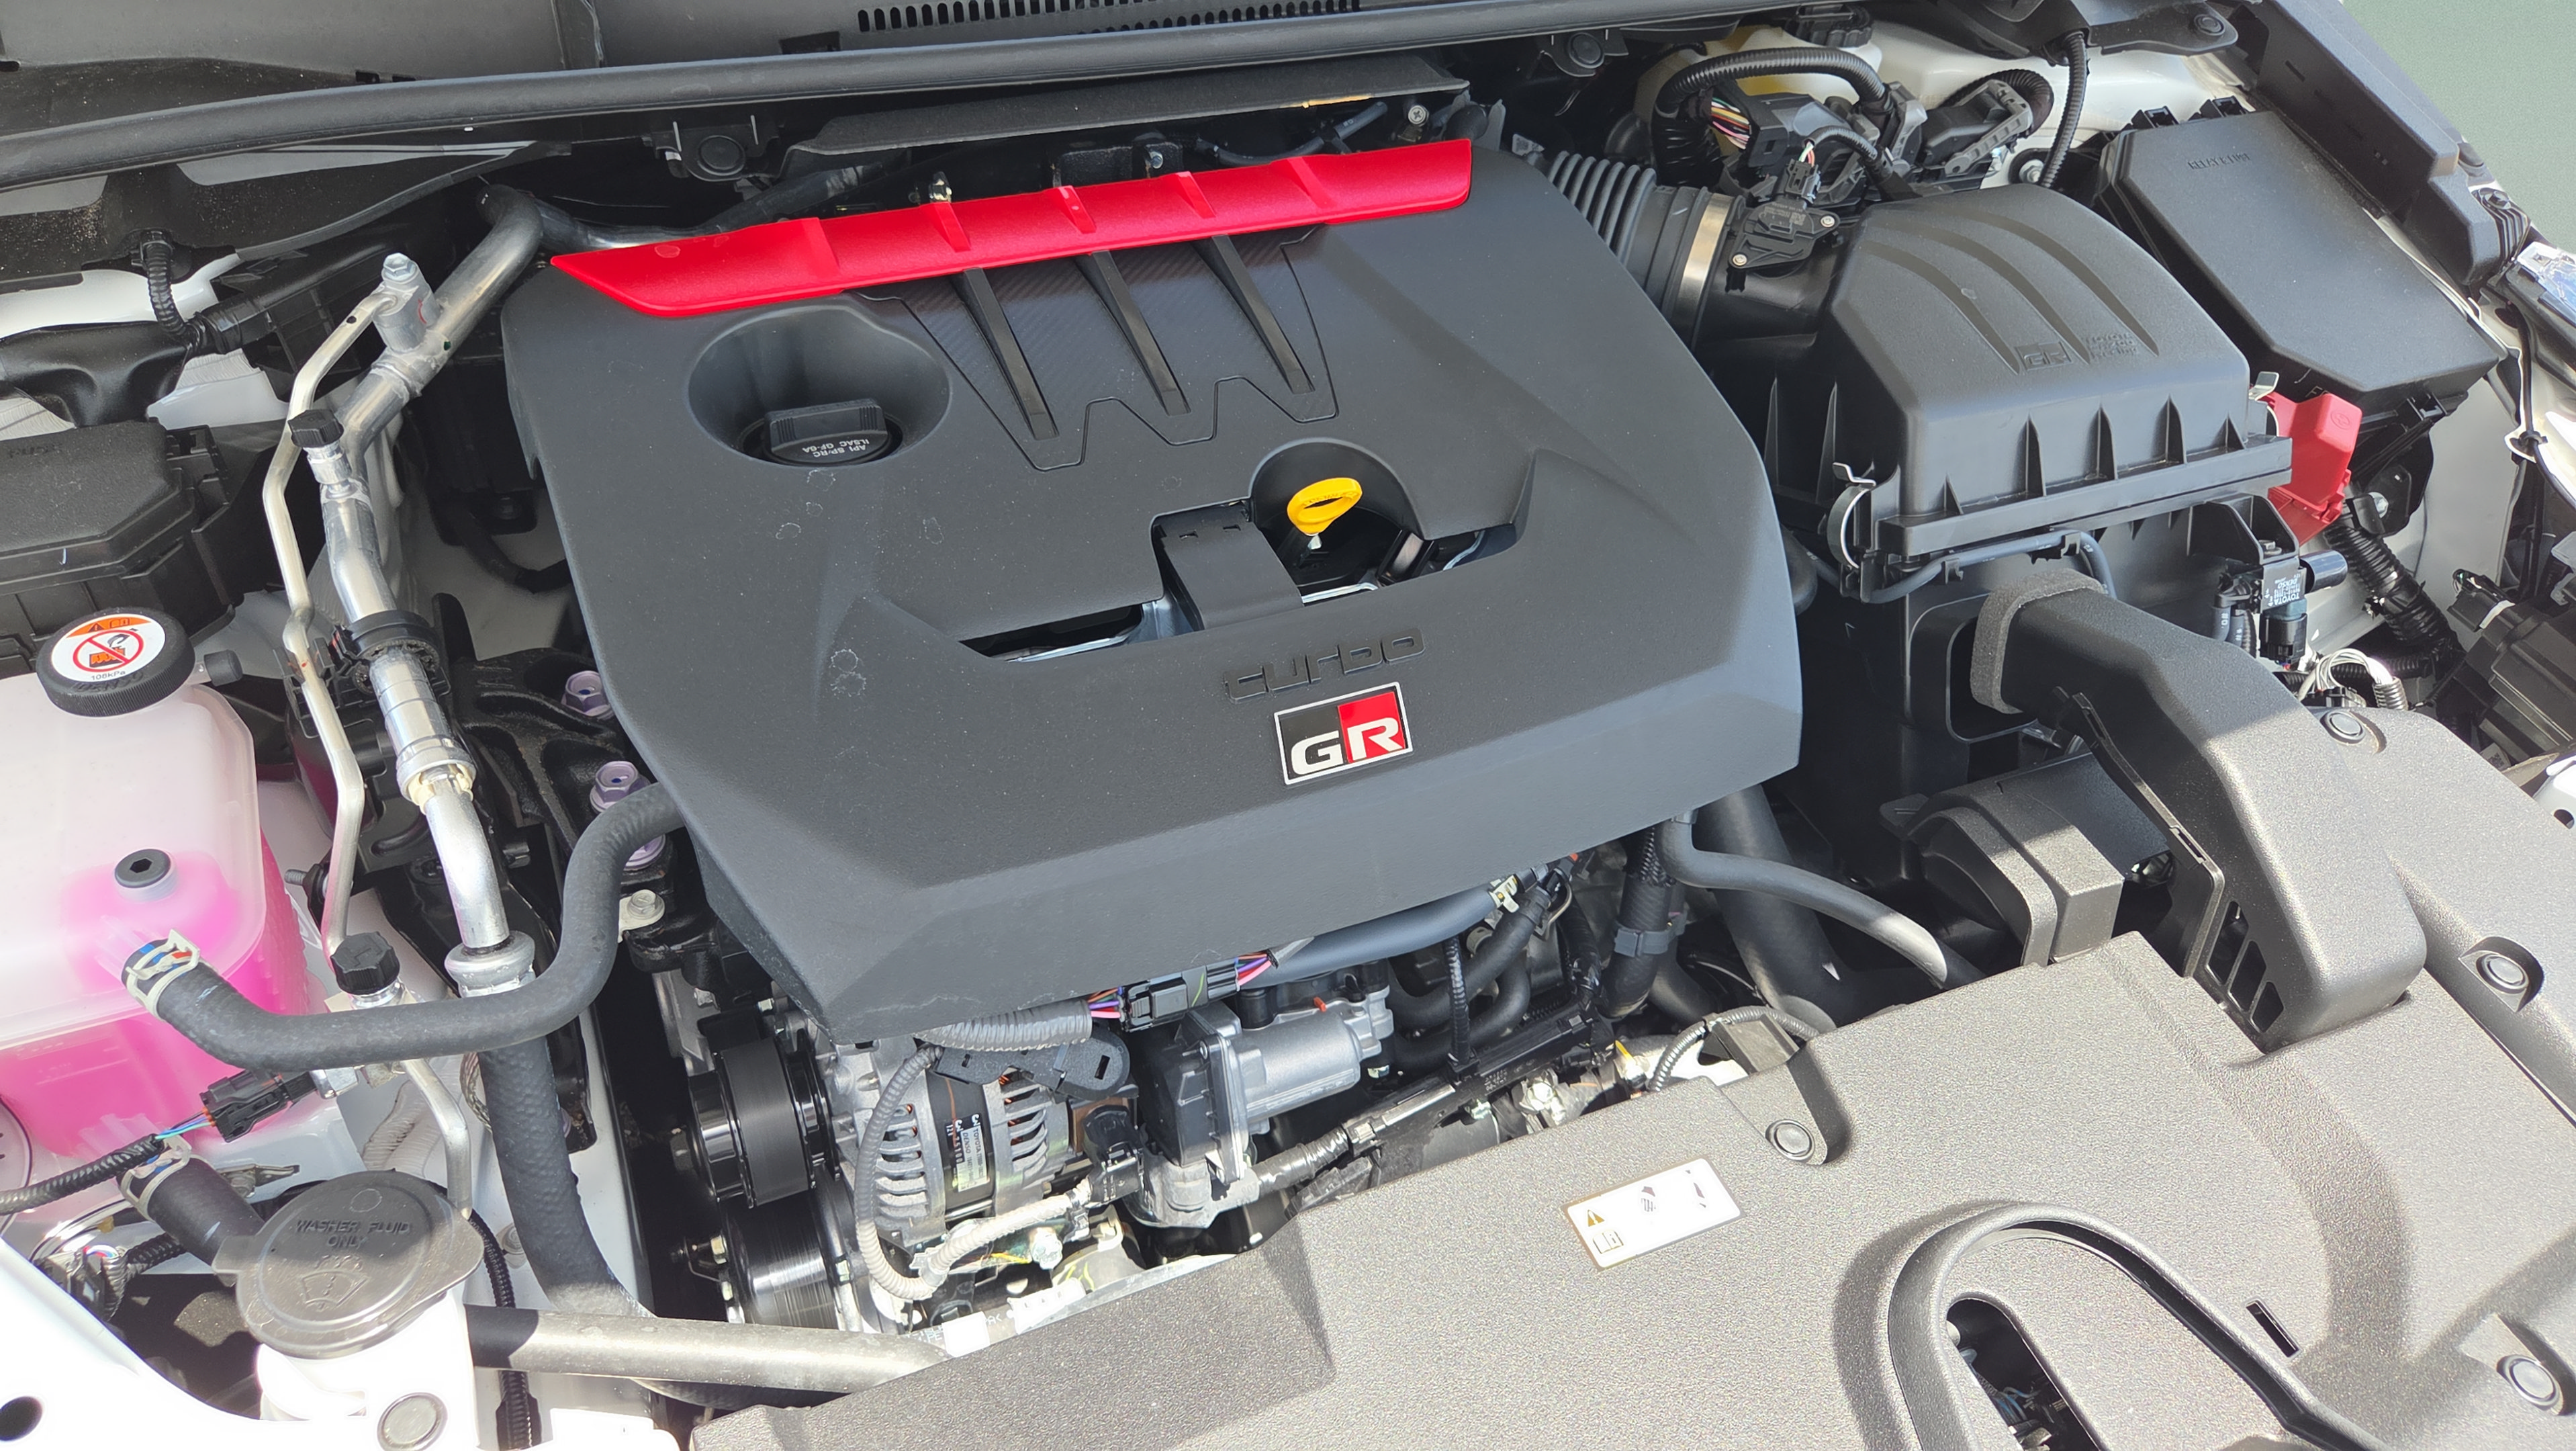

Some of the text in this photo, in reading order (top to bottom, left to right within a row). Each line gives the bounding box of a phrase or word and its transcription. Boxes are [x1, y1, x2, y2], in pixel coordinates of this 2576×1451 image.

[839, 439, 870, 447] ILSAC
[1223, 627, 1426, 703] turbo
[91, 670, 127, 681] 108kPa
[1291, 716, 1404, 775] GR
[962, 1132, 972, 1154] DENSO
[972, 1128, 982, 1153] TOYOTA
[295, 1219, 412, 1234] WASHER FLUID
[327, 1235, 369, 1249] ONLY
